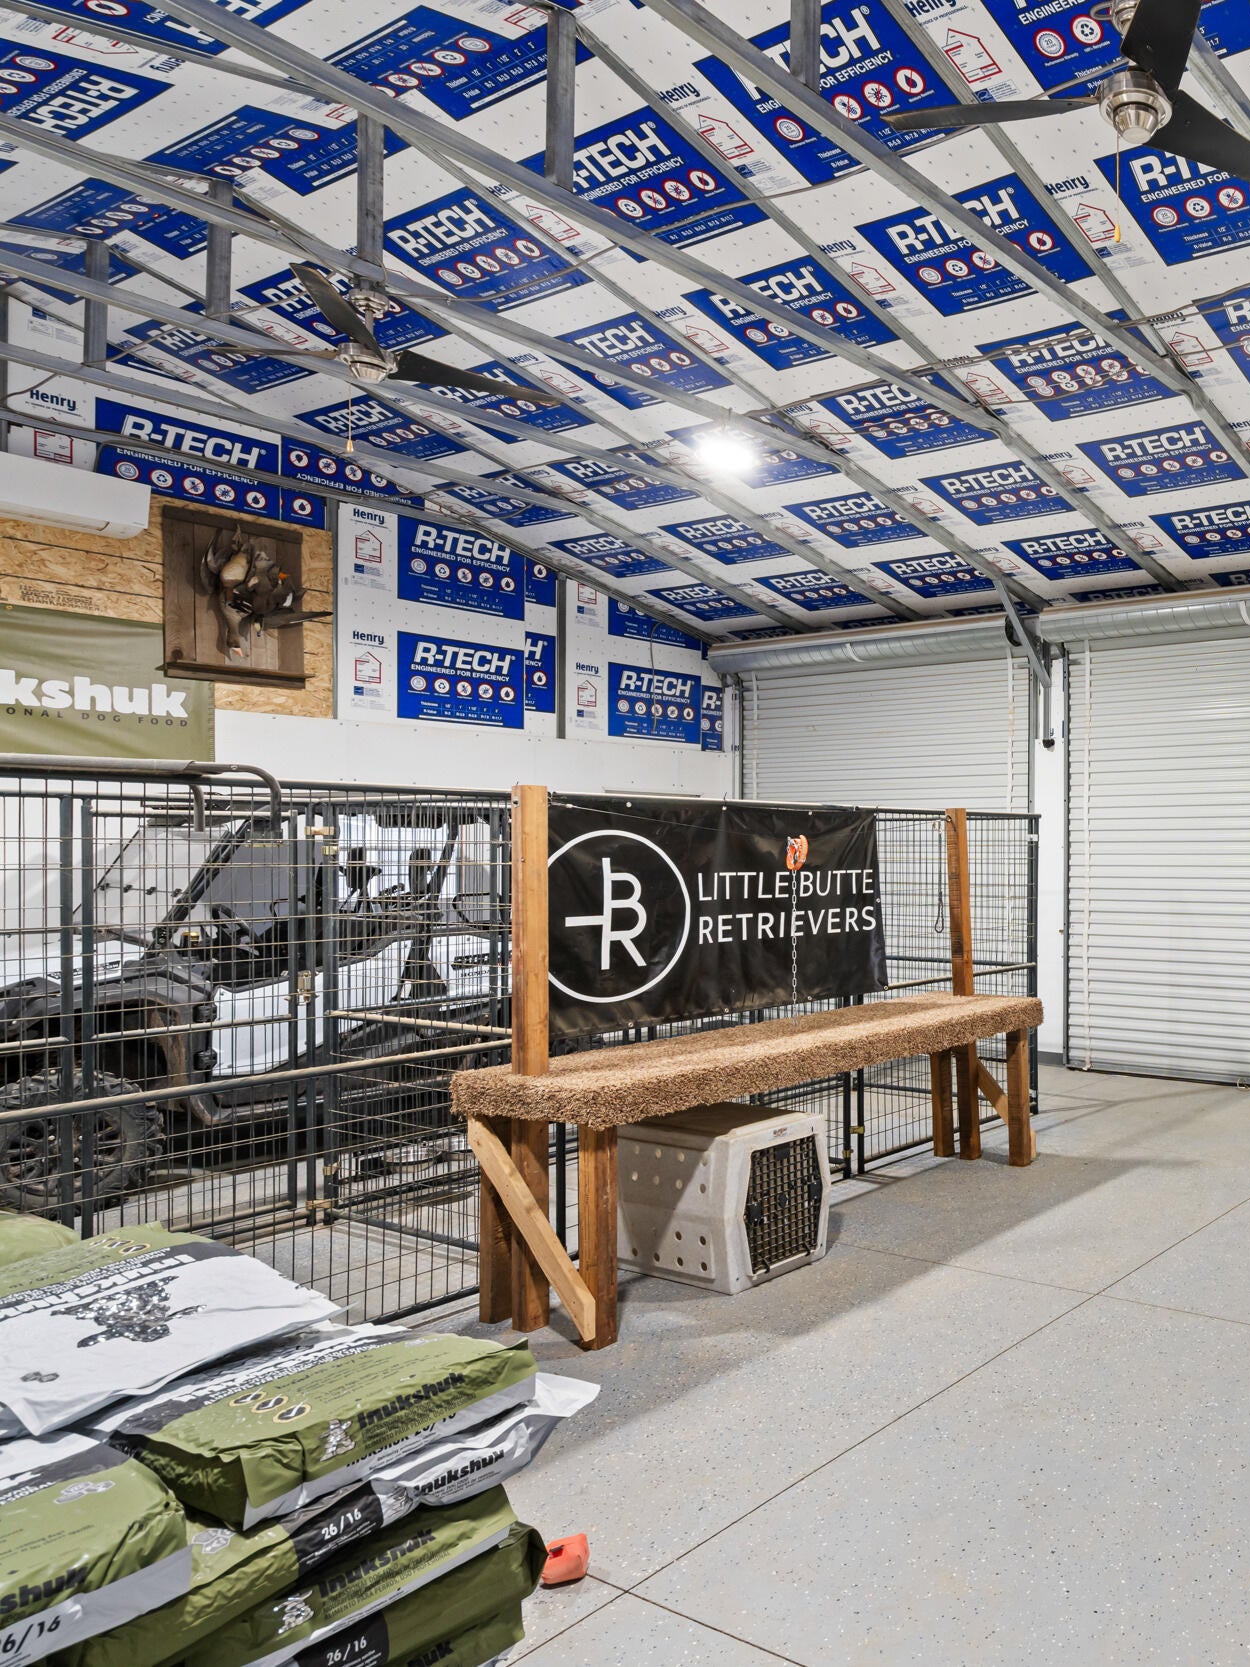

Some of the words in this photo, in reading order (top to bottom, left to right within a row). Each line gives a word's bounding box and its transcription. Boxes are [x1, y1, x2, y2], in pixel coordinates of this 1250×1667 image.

[836, 50, 894, 83] EFFICIENCY
[657, 82, 700, 105] Henry
[622, 174, 641, 187] FOR
[638, 156, 685, 180] EFFICIENCY
[1044, 175, 1089, 196] Henry
[1141, 178, 1206, 203] ENGINEERED
[1207, 172, 1231, 188] FOR
[818, 239, 857, 255] Henry
[30, 389, 77, 412] Henry
[353, 508, 385, 525] Henry
[411, 545, 455, 561] ENGINEERED
[457, 555, 471, 564] FOR
[472, 558, 510, 573] EFFICIENCY
[352, 630, 385, 646] Henry
[410, 663, 455, 675] ENGINEERED
[456, 669, 470, 677] FOR
[472, 671, 510, 682] EFFICIENCY
[576, 662, 599, 675] Henry
[81, 712, 121, 723] DOG
[138, 717, 188, 727] FOOD
[697, 872, 790, 901] LITTLE
[799, 869, 874, 898] BUTTE
[698, 906, 877, 945] RETRIEVERS
[357, 1372, 466, 1429] Inukshuk
[321, 1508, 362, 1541] 26/16
[318, 1527, 436, 1598] Inukshuk
[326, 1636, 368, 1667] 26/16
